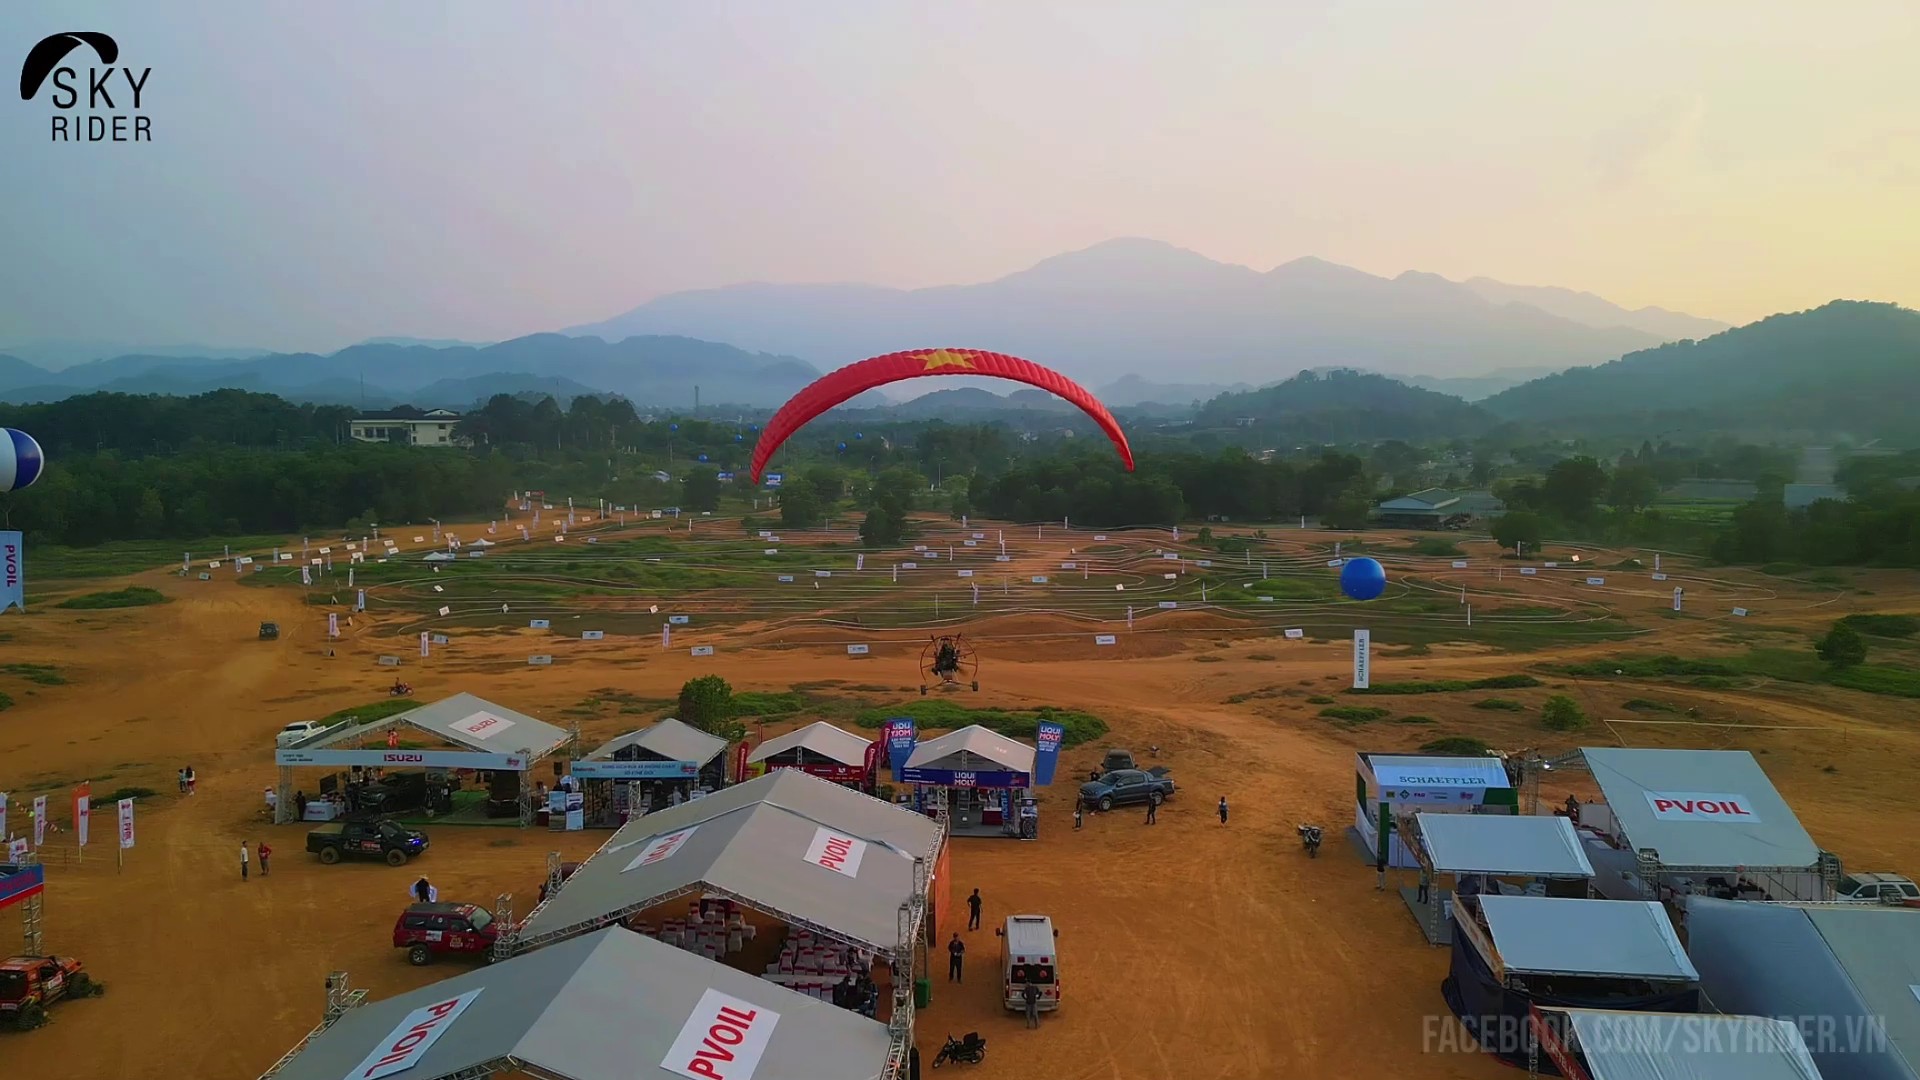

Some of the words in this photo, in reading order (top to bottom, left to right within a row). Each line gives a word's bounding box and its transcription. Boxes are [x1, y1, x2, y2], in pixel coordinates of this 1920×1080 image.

[5, 545, 17, 587] PVOIL
[467, 718, 498, 733] ISUZU
[1040, 732, 1060, 742] MOLY
[383, 754, 422, 762] ISUZU
[954, 772, 975, 780] LIQUI
[1399, 776, 1487, 785] SCHAEFFLER
[1654, 799, 1750, 815] PVOIL
[819, 836, 852, 871] PVOIL
[363, 999, 460, 1078] PVOIL
[687, 1006, 757, 1080] PVOIL
